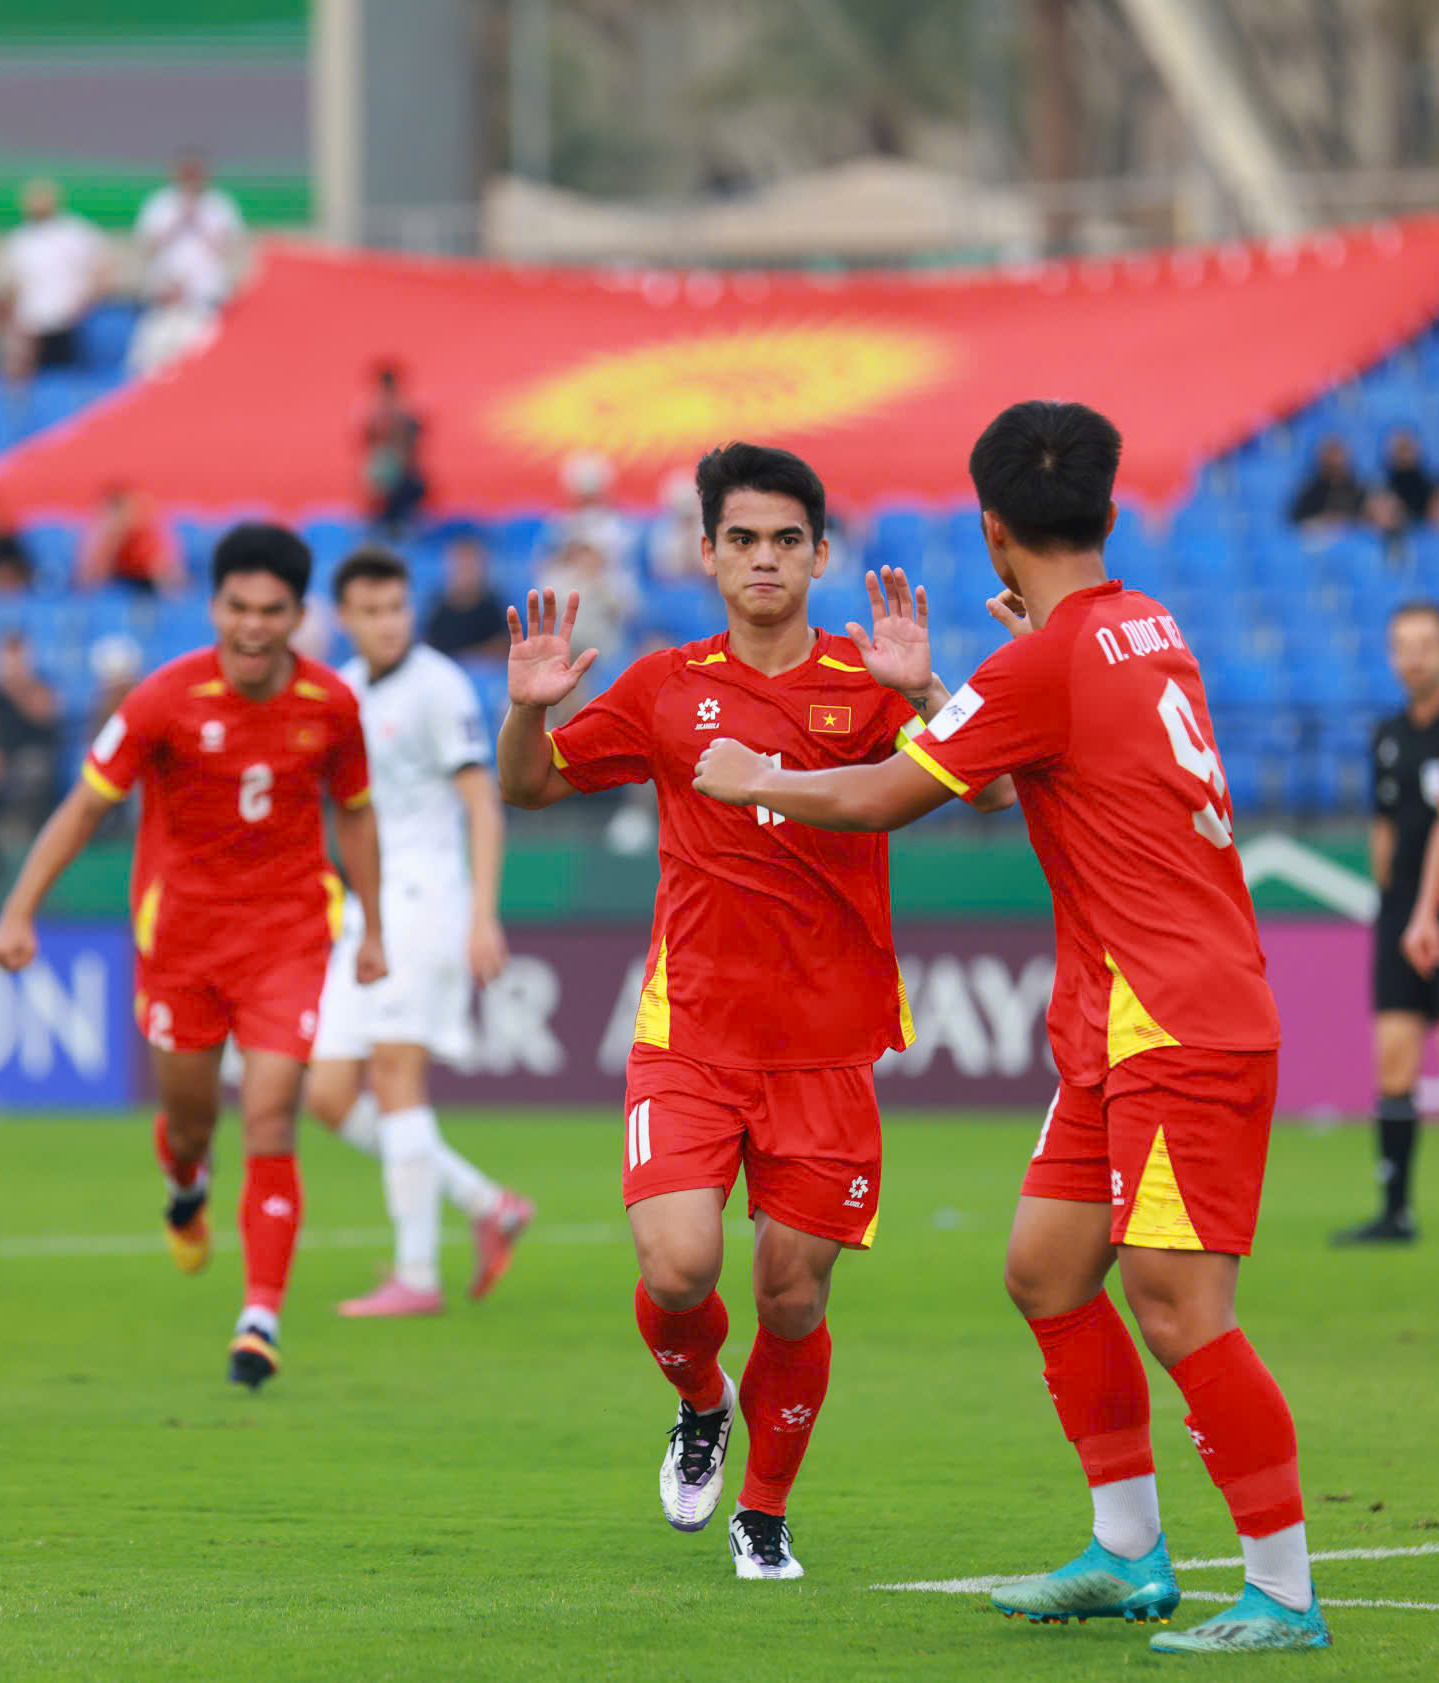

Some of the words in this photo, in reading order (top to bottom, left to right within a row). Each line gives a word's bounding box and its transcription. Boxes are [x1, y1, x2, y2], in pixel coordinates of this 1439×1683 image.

[1121, 616, 1170, 657] QUOC
[1157, 677, 1233, 850] 9
[628, 1097, 652, 1172] 11
